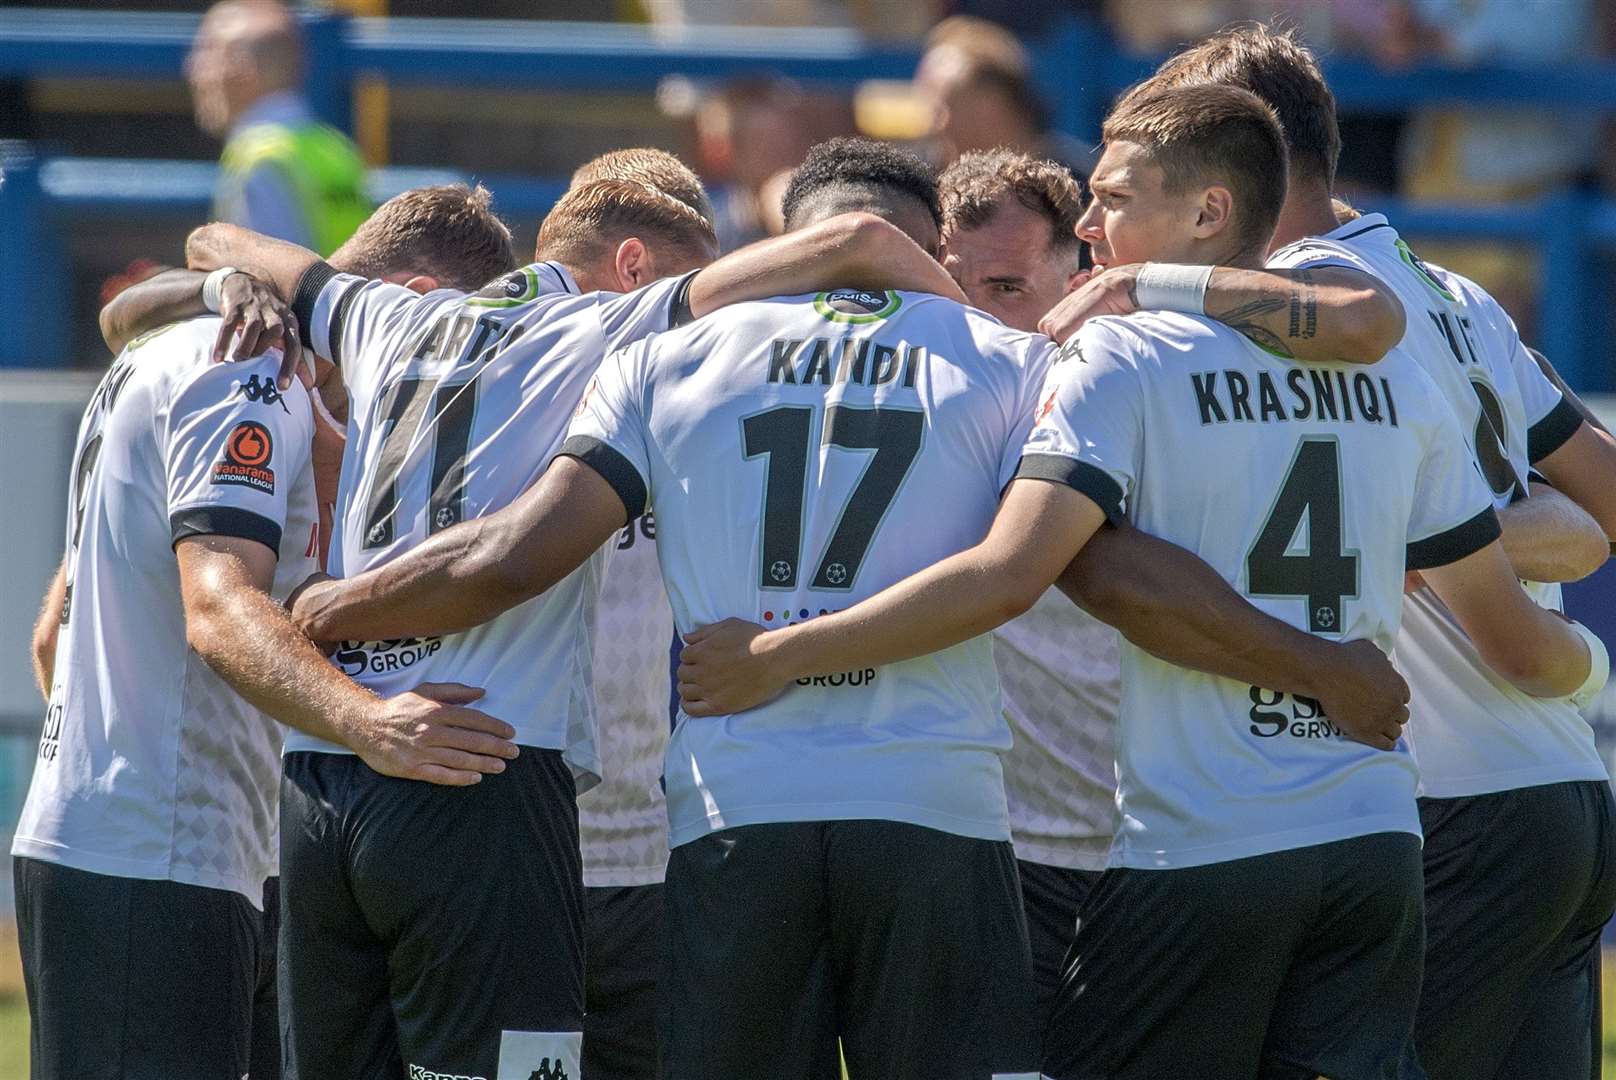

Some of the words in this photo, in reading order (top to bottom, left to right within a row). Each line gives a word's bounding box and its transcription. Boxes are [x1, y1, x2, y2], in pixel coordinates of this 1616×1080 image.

[767, 338, 919, 389] KANDI
[1190, 368, 1399, 428] KRASNIQI
[214, 474, 249, 482] NATIONAL
[740, 404, 926, 592] 17
[1245, 435, 1361, 634] 4
[370, 640, 441, 673] GROUP
